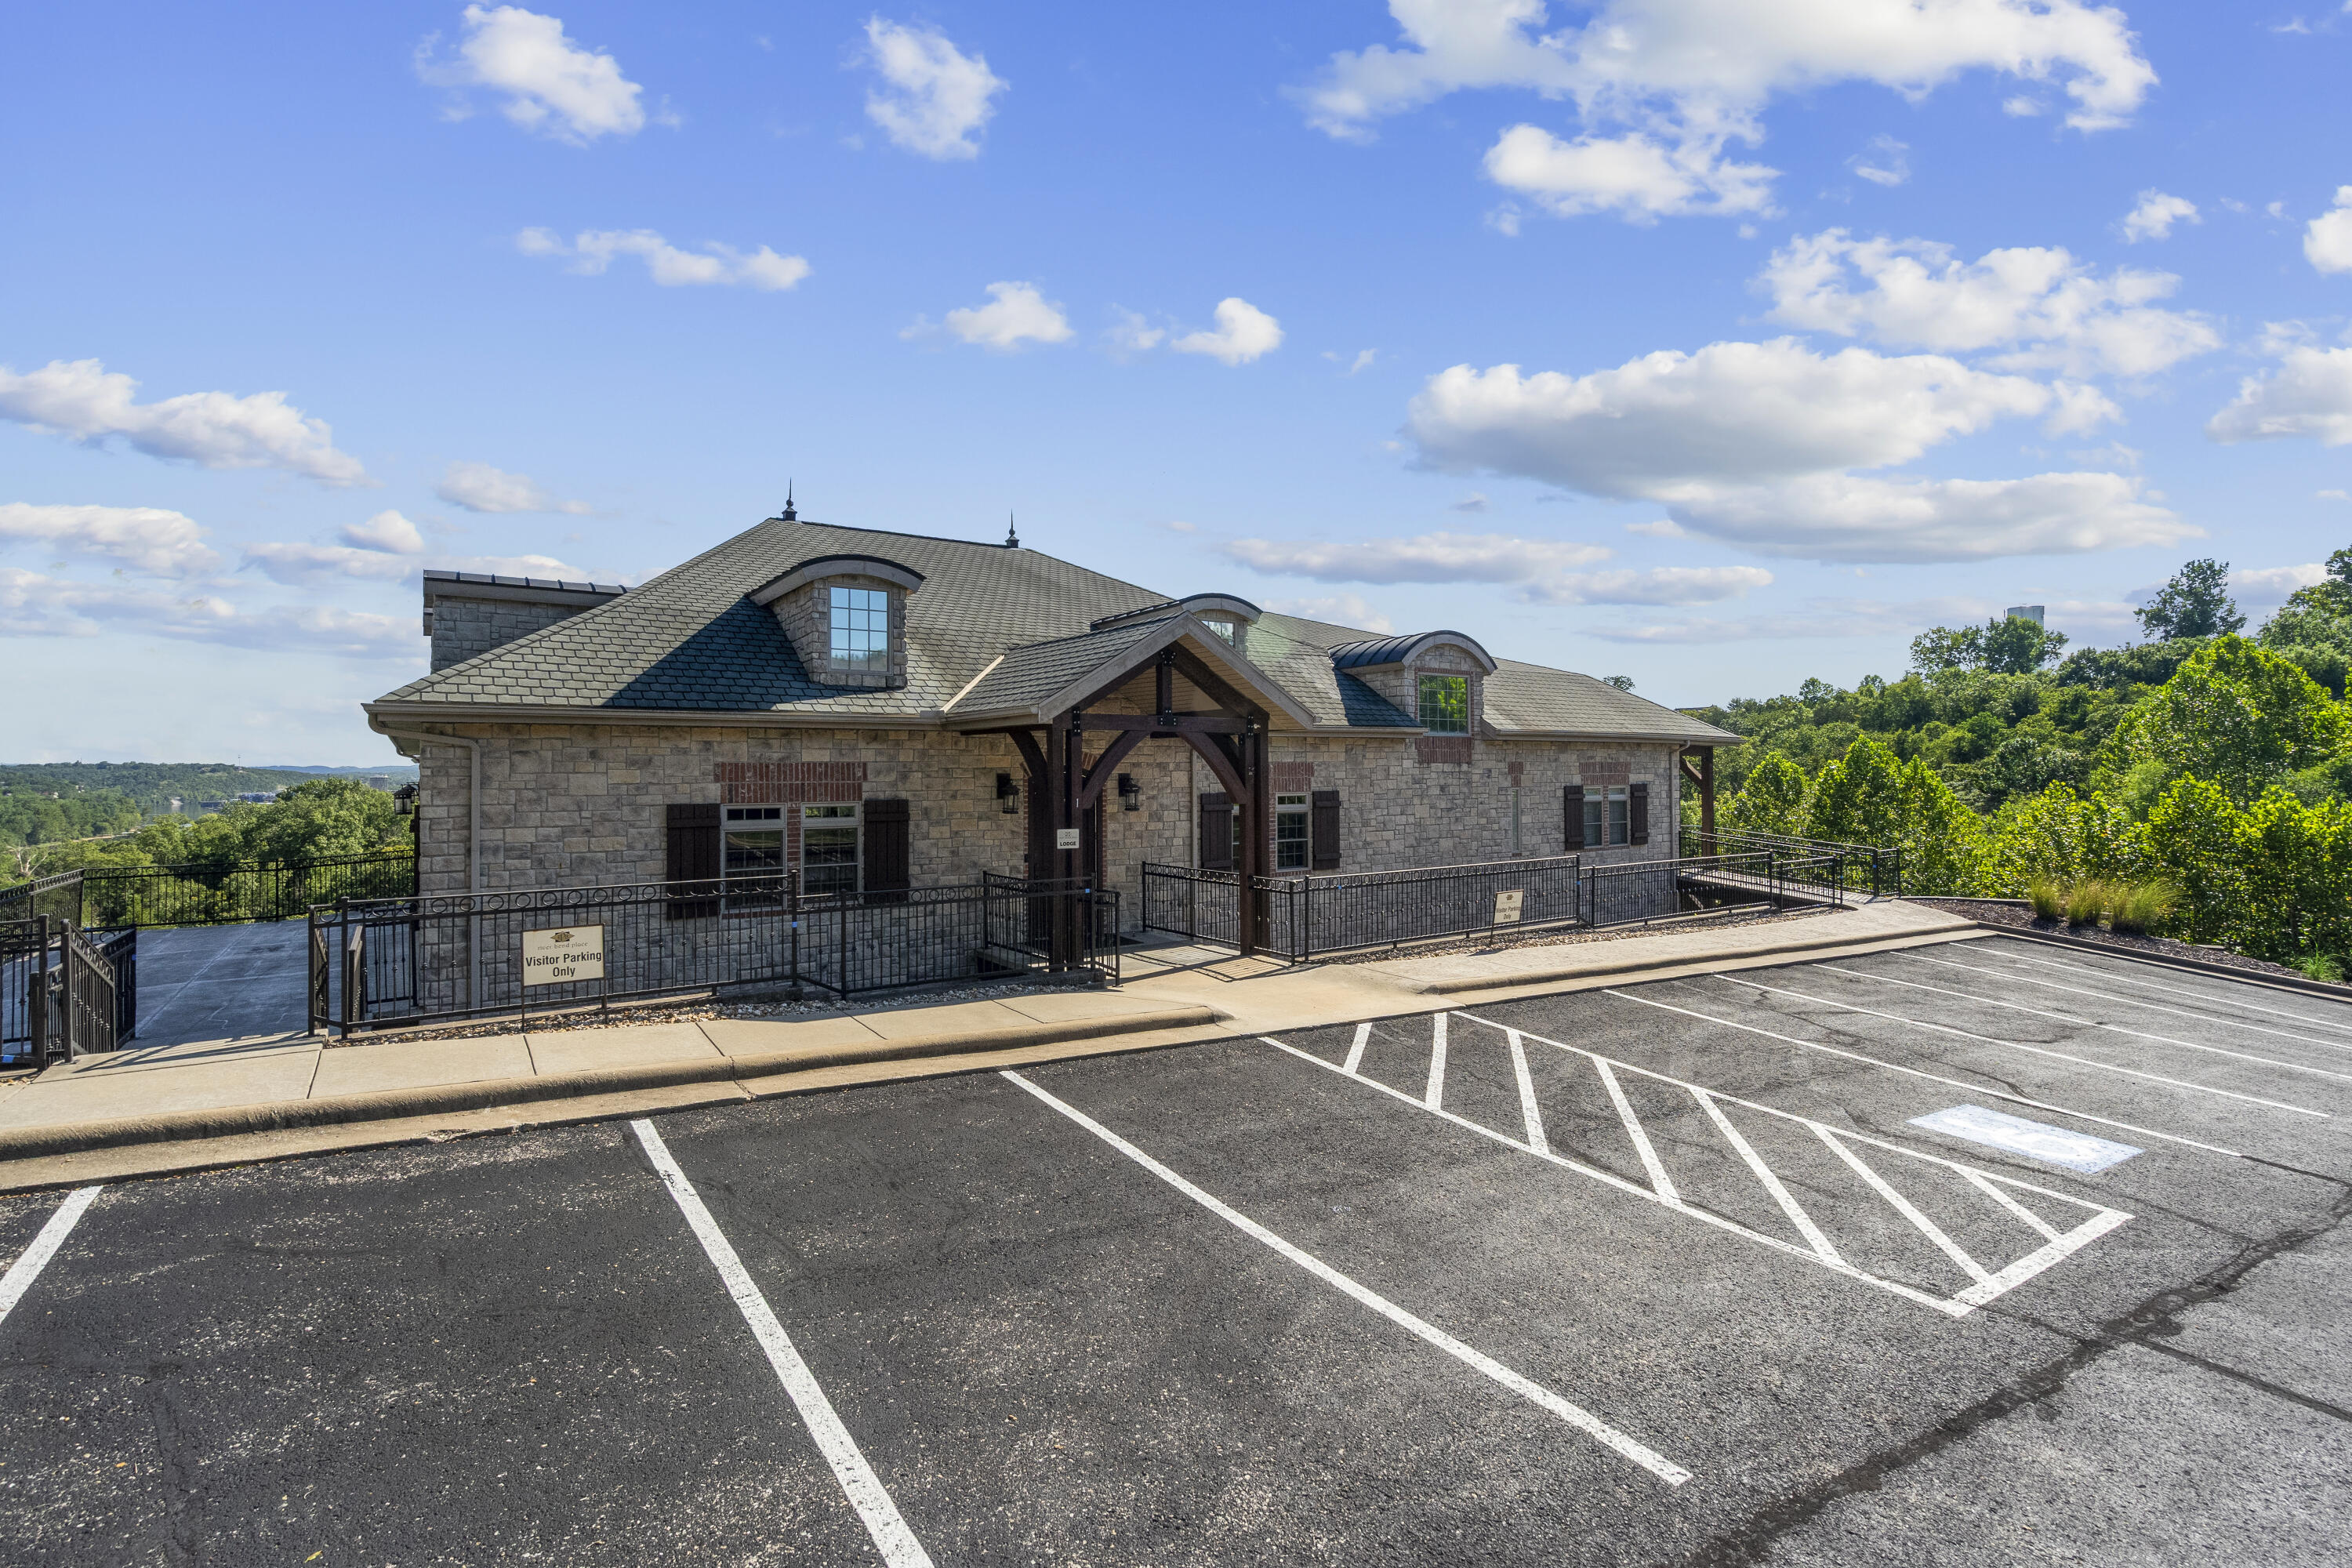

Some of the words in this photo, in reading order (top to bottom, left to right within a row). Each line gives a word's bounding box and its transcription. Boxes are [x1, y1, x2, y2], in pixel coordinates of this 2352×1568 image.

[525, 956, 560, 967] Visitor
[563, 951, 602, 964] Parking
[552, 966, 575, 978] Only
